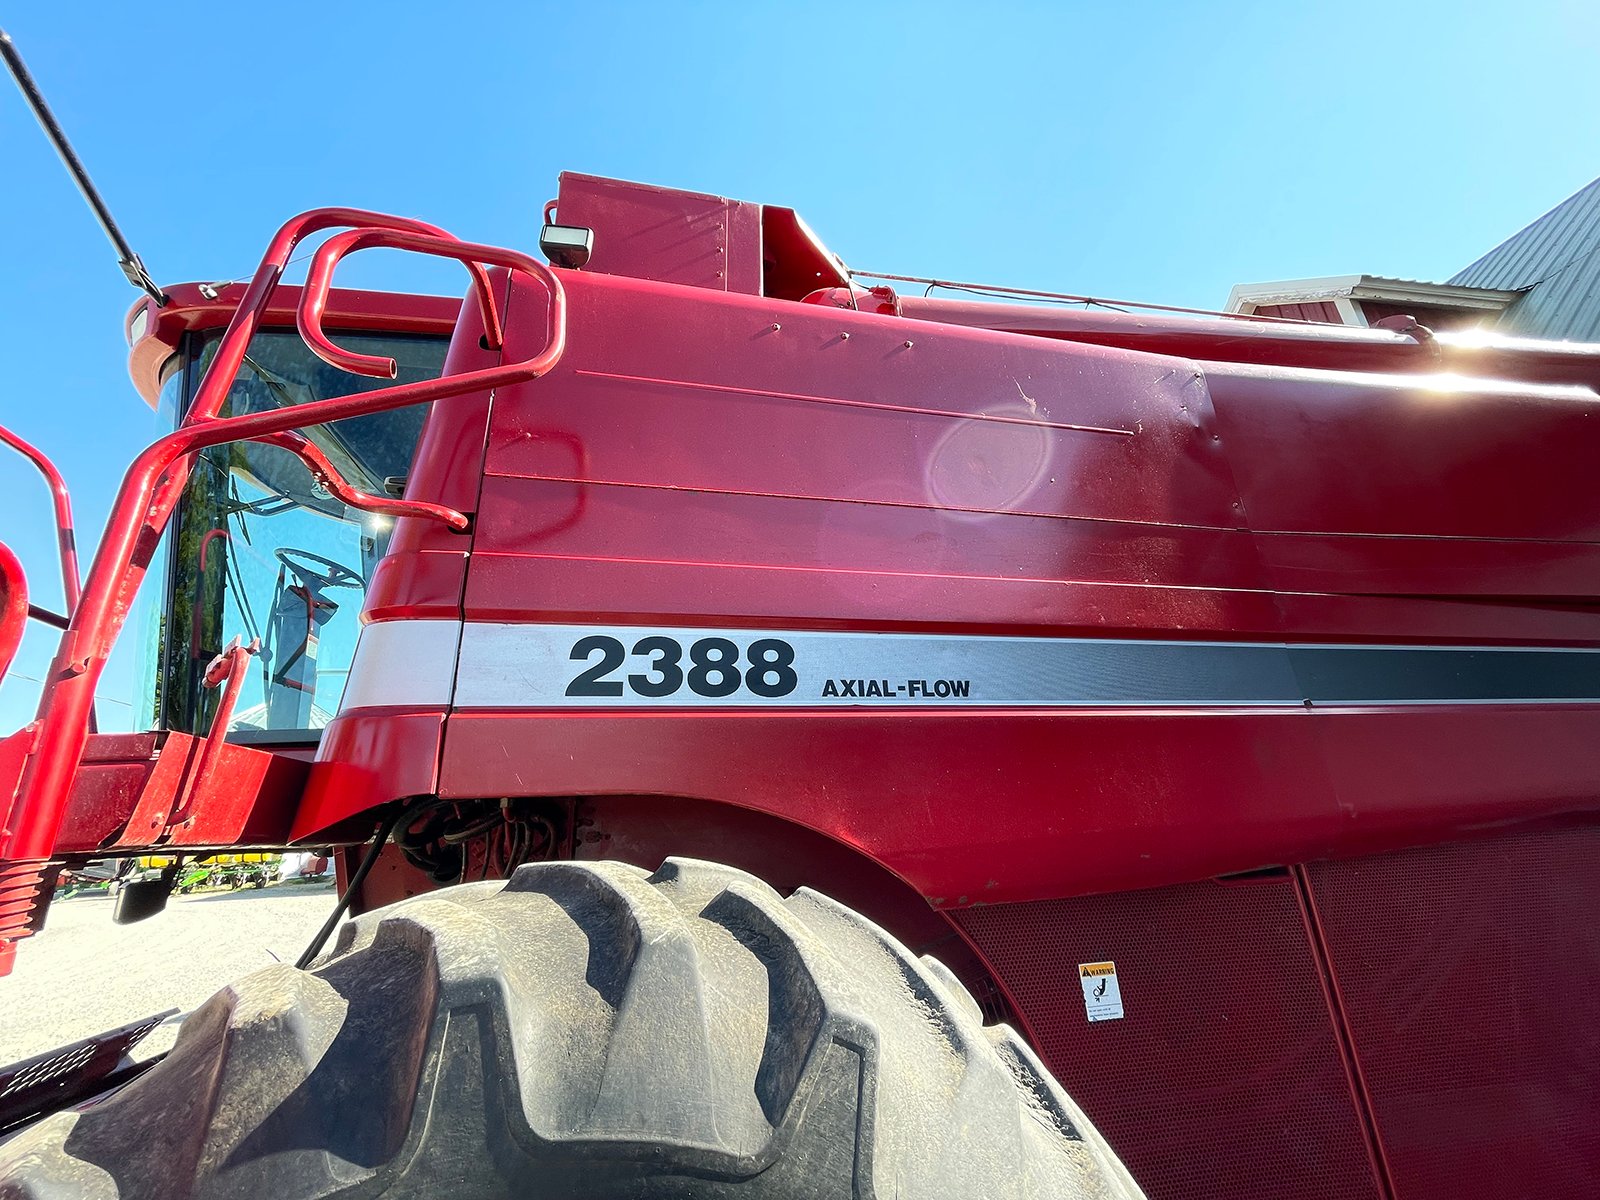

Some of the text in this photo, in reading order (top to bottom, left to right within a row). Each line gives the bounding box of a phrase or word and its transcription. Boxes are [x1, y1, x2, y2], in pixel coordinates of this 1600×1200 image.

[565, 636, 970, 697] 2388 AXIAL-FLOW
[1091, 968, 1114, 976] WARNING
